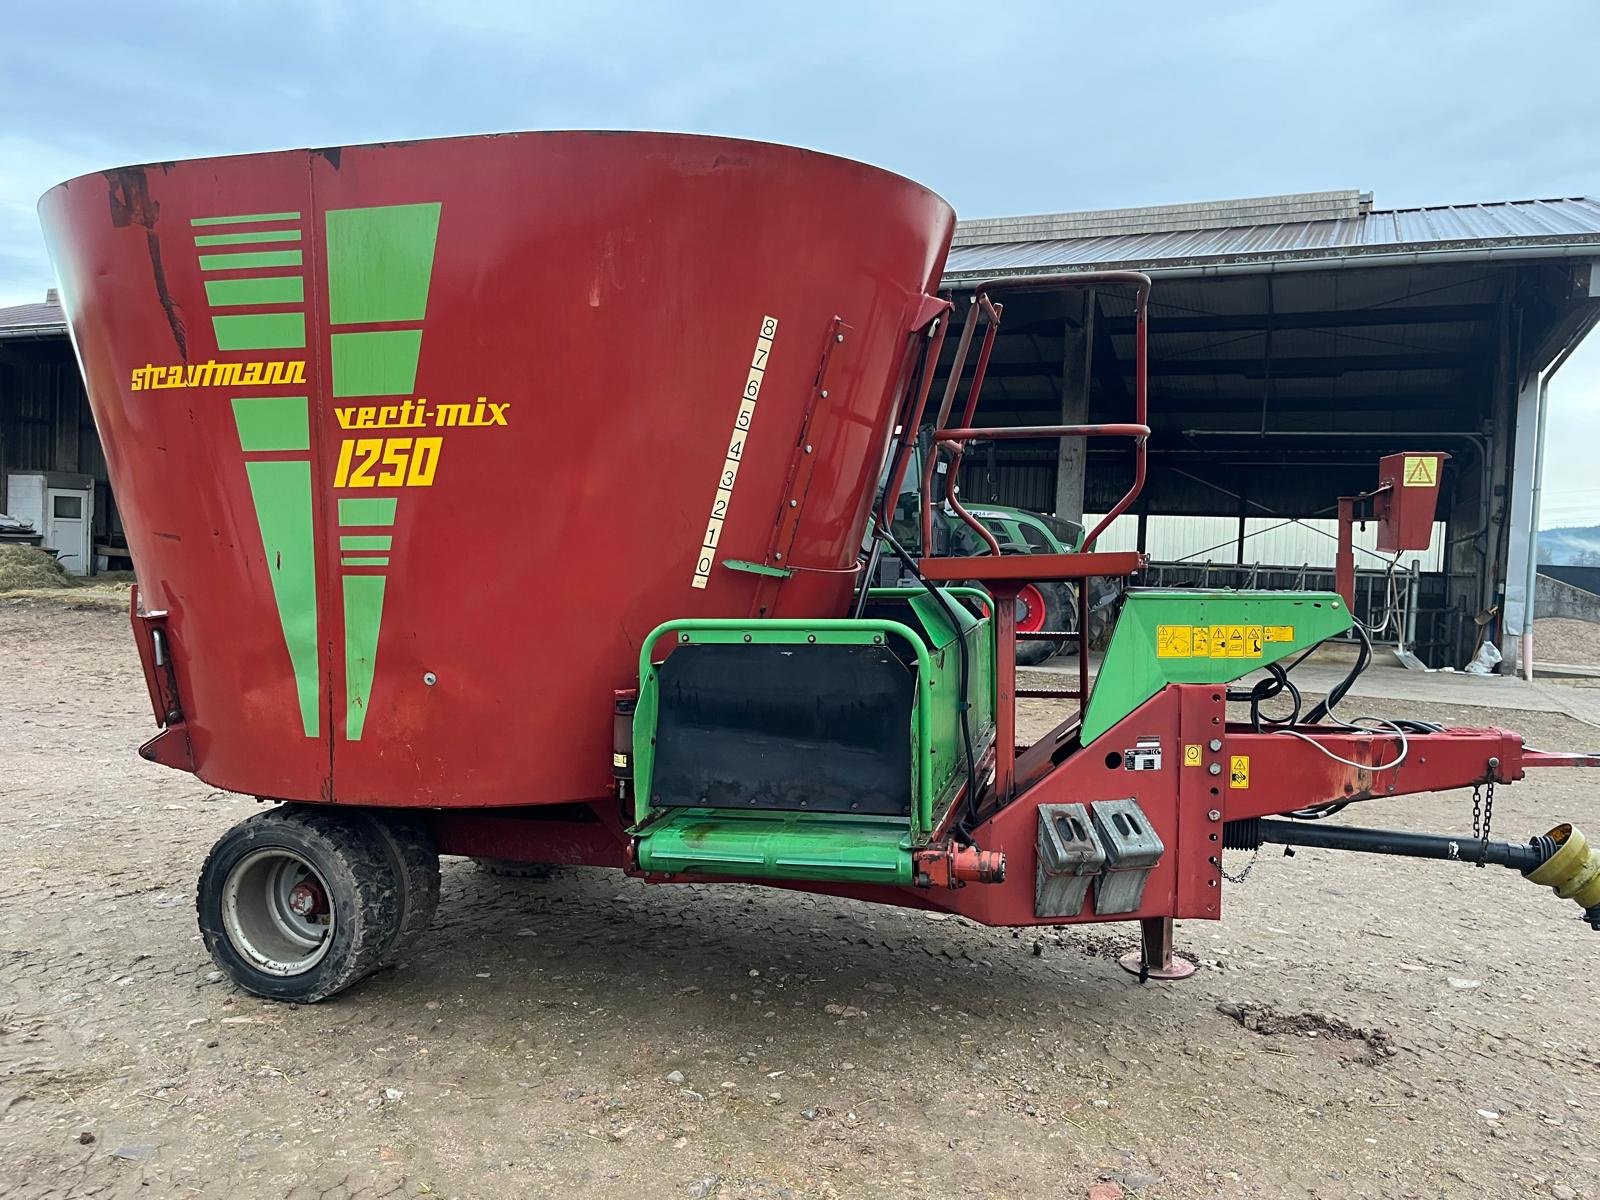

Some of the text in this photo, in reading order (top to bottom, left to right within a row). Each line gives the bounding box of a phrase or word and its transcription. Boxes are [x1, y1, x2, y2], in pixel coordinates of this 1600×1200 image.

[763, 320, 774, 335] 8
[757, 349, 767, 365] 7
[131, 360, 306, 391] strautmann
[748, 380, 758, 396] 6
[332, 396, 510, 430] verti-mix
[739, 411, 750, 426] 5
[731, 441, 741, 457] 4
[333, 436, 443, 488] 1250
[723, 471, 733, 486] 3
[714, 500, 725, 516] 2
[709, 529, 715, 544] 1
[699, 558, 710, 572] 0
